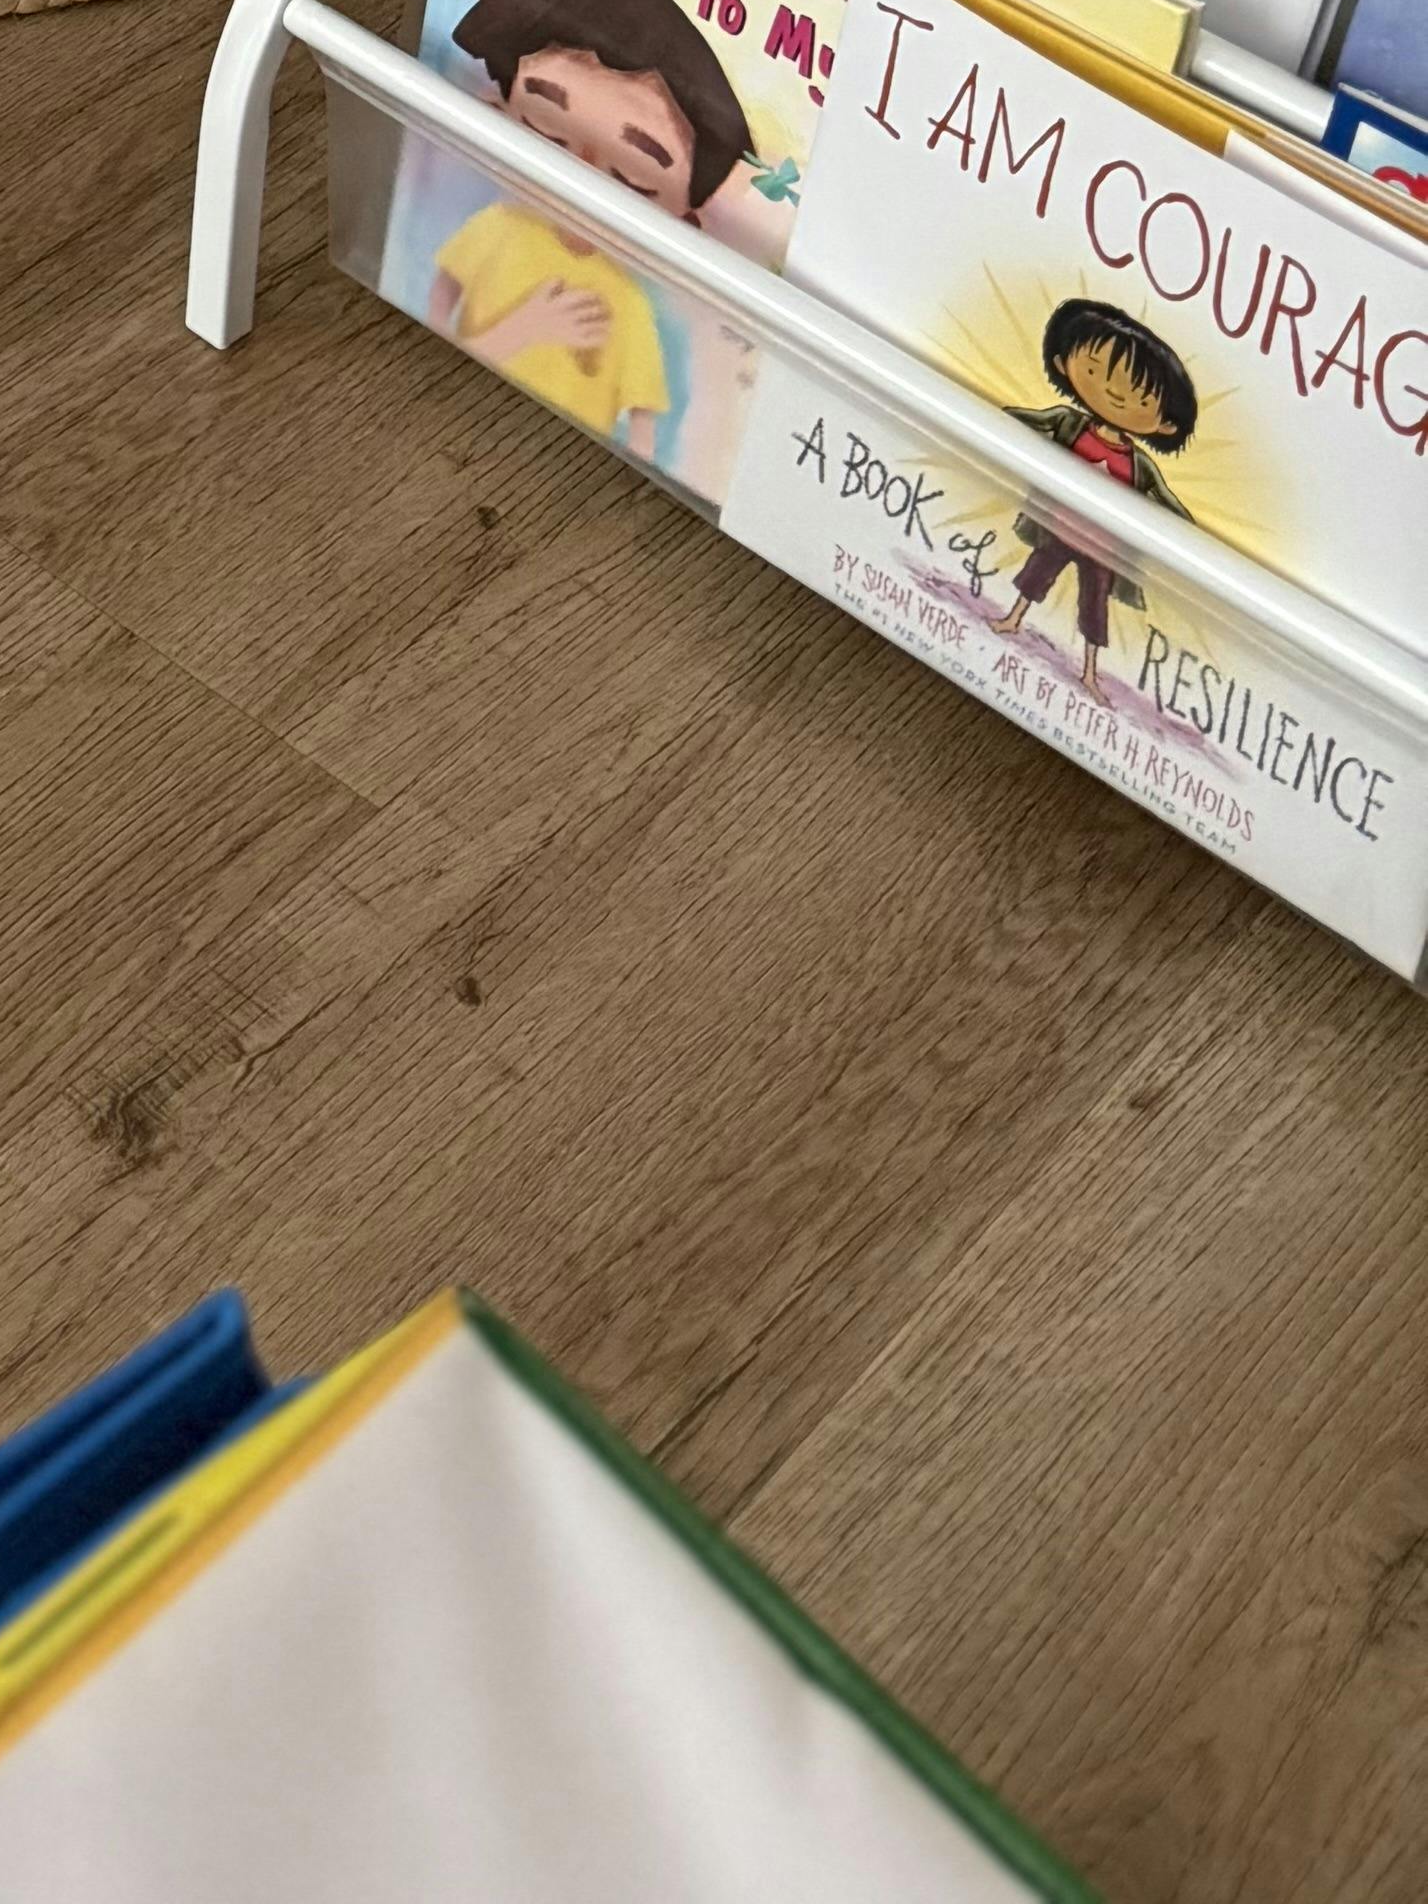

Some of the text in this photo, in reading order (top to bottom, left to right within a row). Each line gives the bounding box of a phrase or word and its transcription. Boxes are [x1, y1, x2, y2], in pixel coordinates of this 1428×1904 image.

[864, 1, 935, 141] I
[927, 63, 1066, 220] AM
[791, 417, 1395, 842] A BOOK of RESILIENCE
[833, 543, 859, 582] BY
[862, 563, 912, 618] SUSAN
[918, 597, 969, 651] VERDE
[992, 651, 1030, 695] ART
[1036, 676, 1058, 709] BY
[1064, 691, 1118, 751] PETER
[1144, 745, 1256, 842] REYNOLDS
[894, 622, 935, 653] NEW
[940, 653, 988, 690] YORK
[995, 689, 1050, 731] TIMES
[1052, 726, 1177, 814] BESTSELLING
[1182, 812, 1238, 856] TEAM
